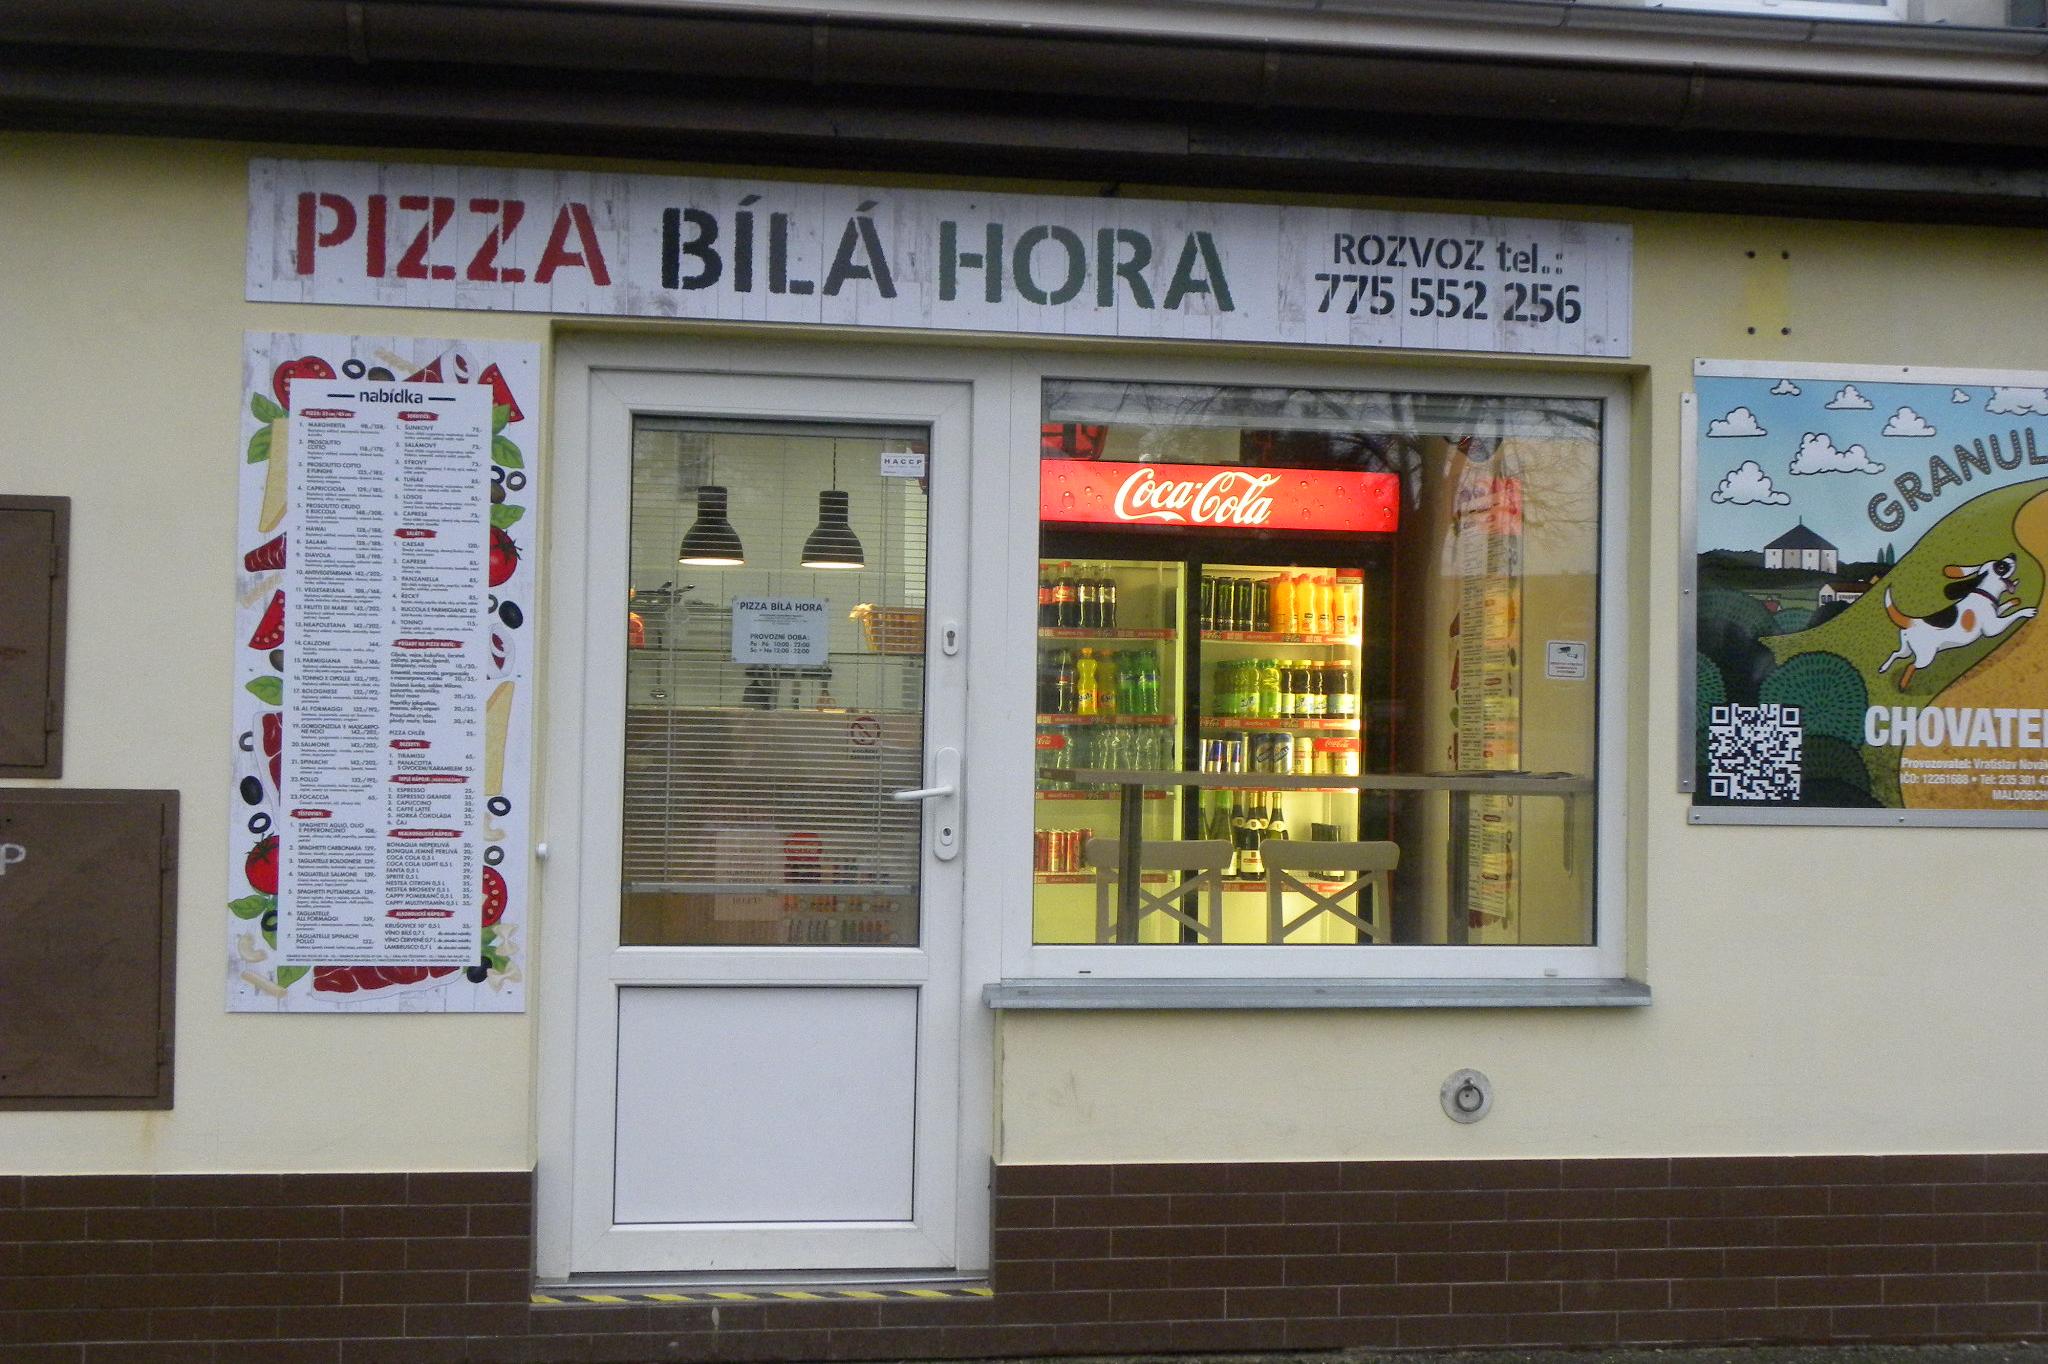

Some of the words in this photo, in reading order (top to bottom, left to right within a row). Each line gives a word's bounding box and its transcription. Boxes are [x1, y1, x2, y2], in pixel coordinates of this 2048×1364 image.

[296, 192, 611, 286] PIZZA
[662, 194, 897, 298] BÍLÁ
[938, 220, 1236, 312] HORA
[1334, 232, 1485, 272] ROZVOZ
[1495, 237, 1563, 275] tel.:
[1314, 272, 1396, 316] 775
[1409, 276, 1489, 321] 552
[1502, 281, 1582, 325] 256
[359, 388, 424, 404] nabídka
[1114, 468, 1281, 524] Coca-Cola
[740, 601, 767, 610] PIZZA
[771, 601, 793, 611] BÍLÁ
[795, 602, 823, 611] HORA
[1864, 705, 2048, 748] CHOVATE
